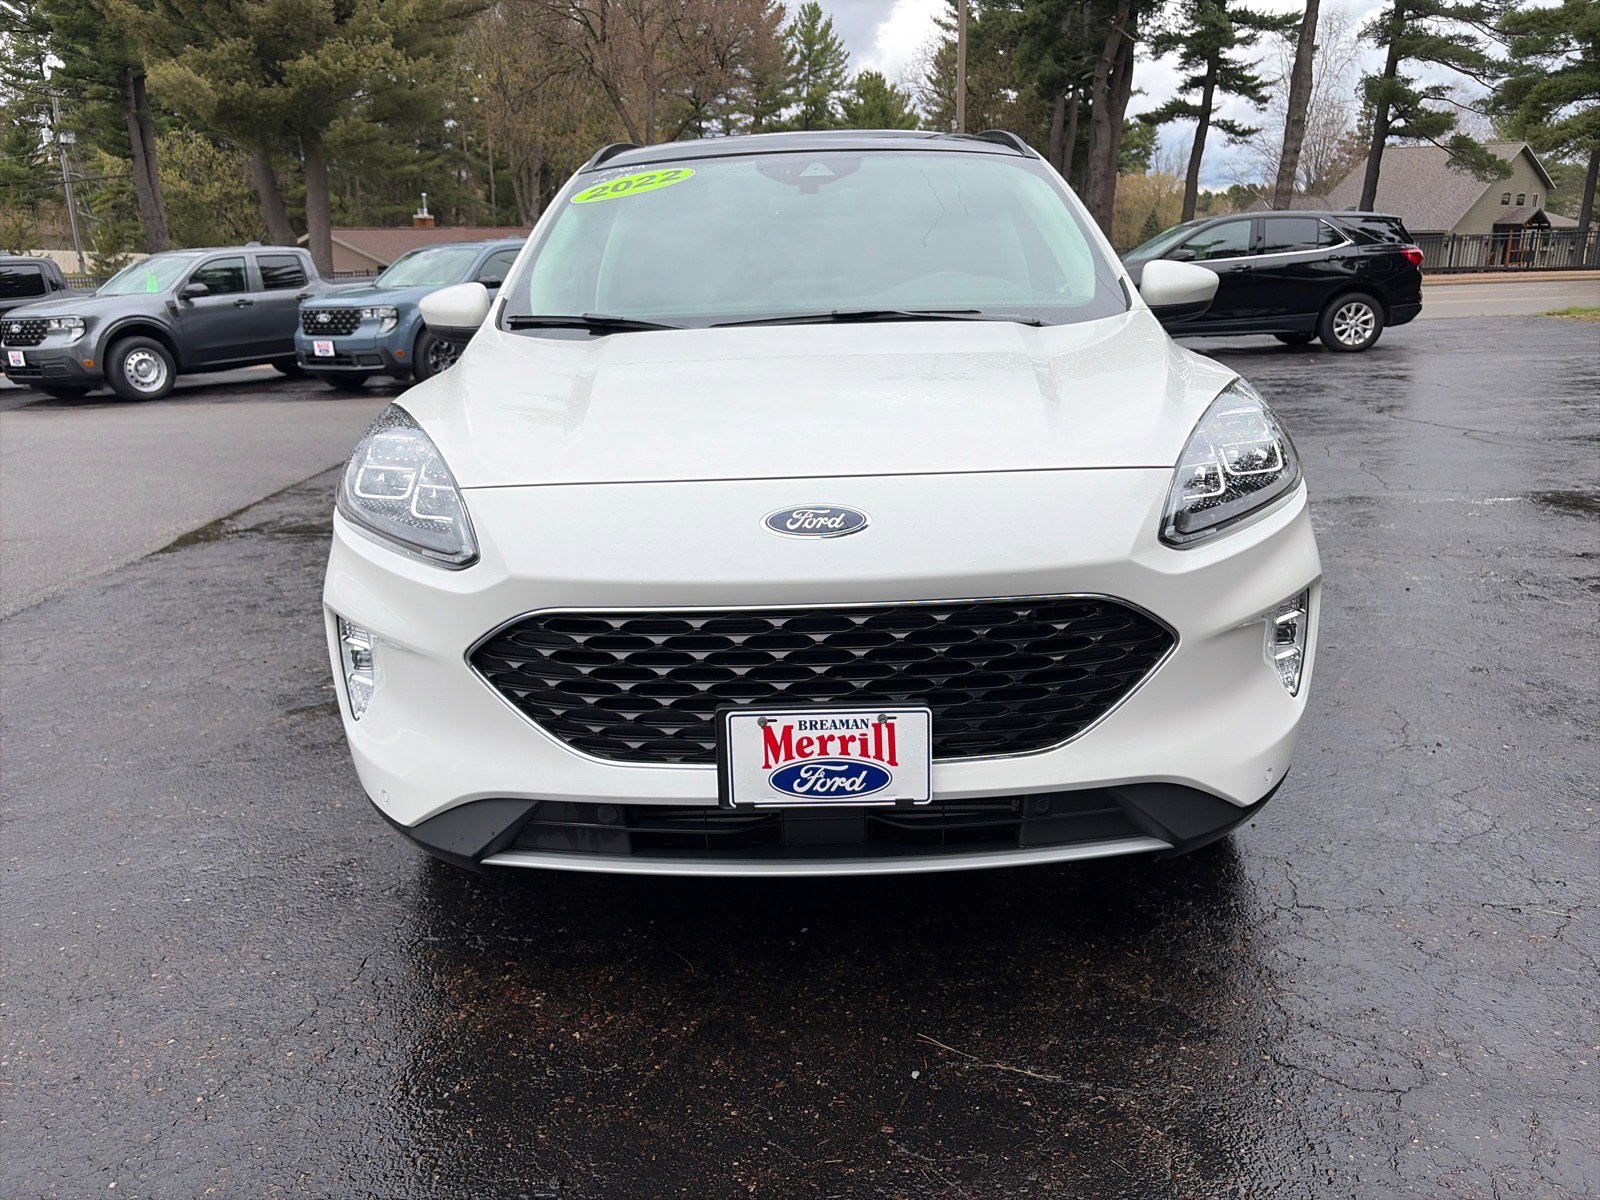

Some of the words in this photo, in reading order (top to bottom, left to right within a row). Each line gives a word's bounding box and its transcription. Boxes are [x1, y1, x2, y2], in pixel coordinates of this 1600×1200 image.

[584, 169, 682, 200] 2022
[786, 509, 846, 530] Ford
[798, 718, 870, 731] BREAMAN
[761, 722, 899, 770] Merrill
[792, 764, 868, 793] Ford
